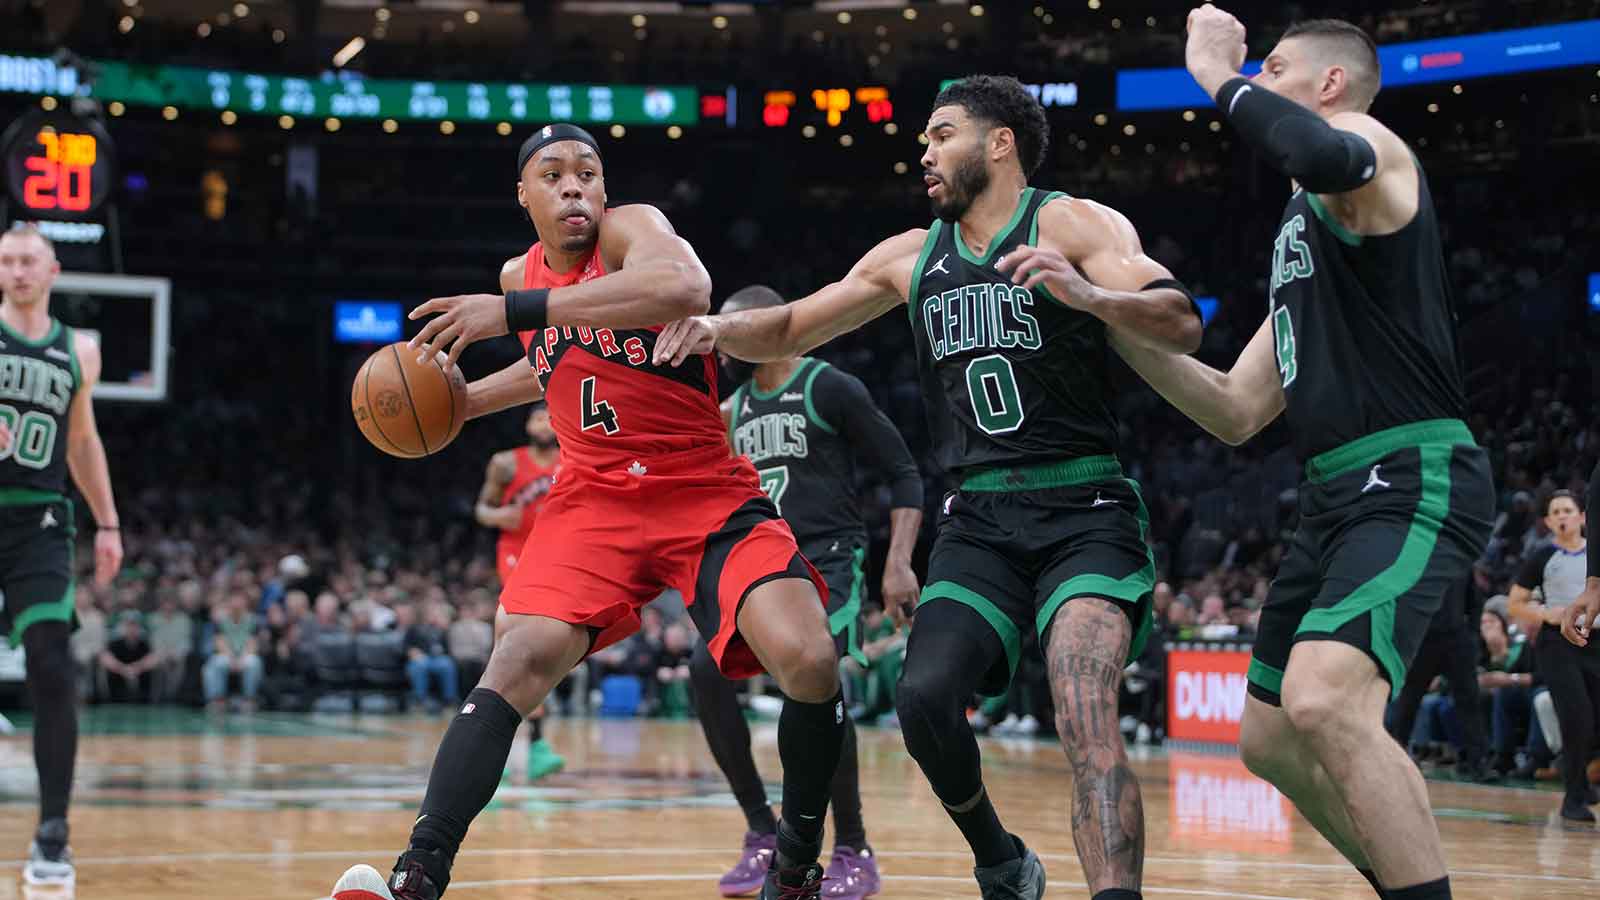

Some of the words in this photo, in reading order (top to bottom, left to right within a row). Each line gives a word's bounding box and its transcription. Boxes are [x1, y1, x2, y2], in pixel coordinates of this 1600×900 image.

[23, 156, 92, 211] 20
[923, 283, 1042, 361] CELTICS
[581, 376, 620, 435] 4
[966, 354, 1024, 434] 0
[759, 466, 789, 517] 7
